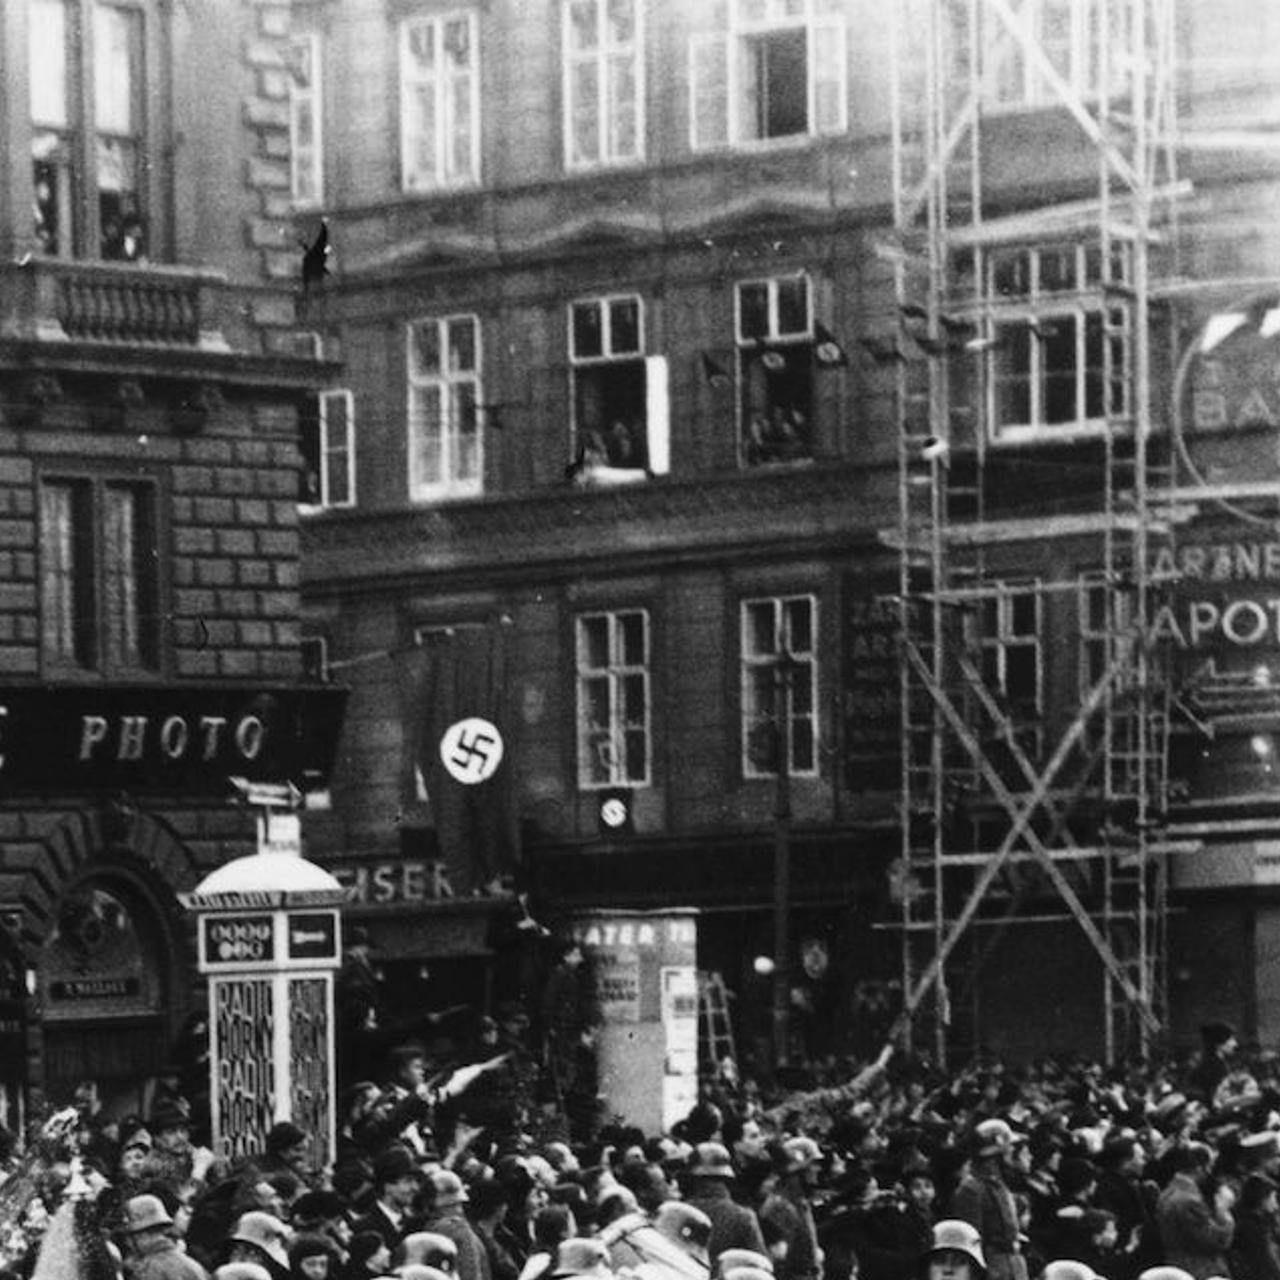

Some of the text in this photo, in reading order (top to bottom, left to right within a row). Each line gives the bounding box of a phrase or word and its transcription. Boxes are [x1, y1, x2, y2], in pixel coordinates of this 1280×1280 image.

[79, 716, 266, 761] PHOTO
[218, 982, 273, 1019] RADIO
[220, 1060, 275, 1099] RADIO
